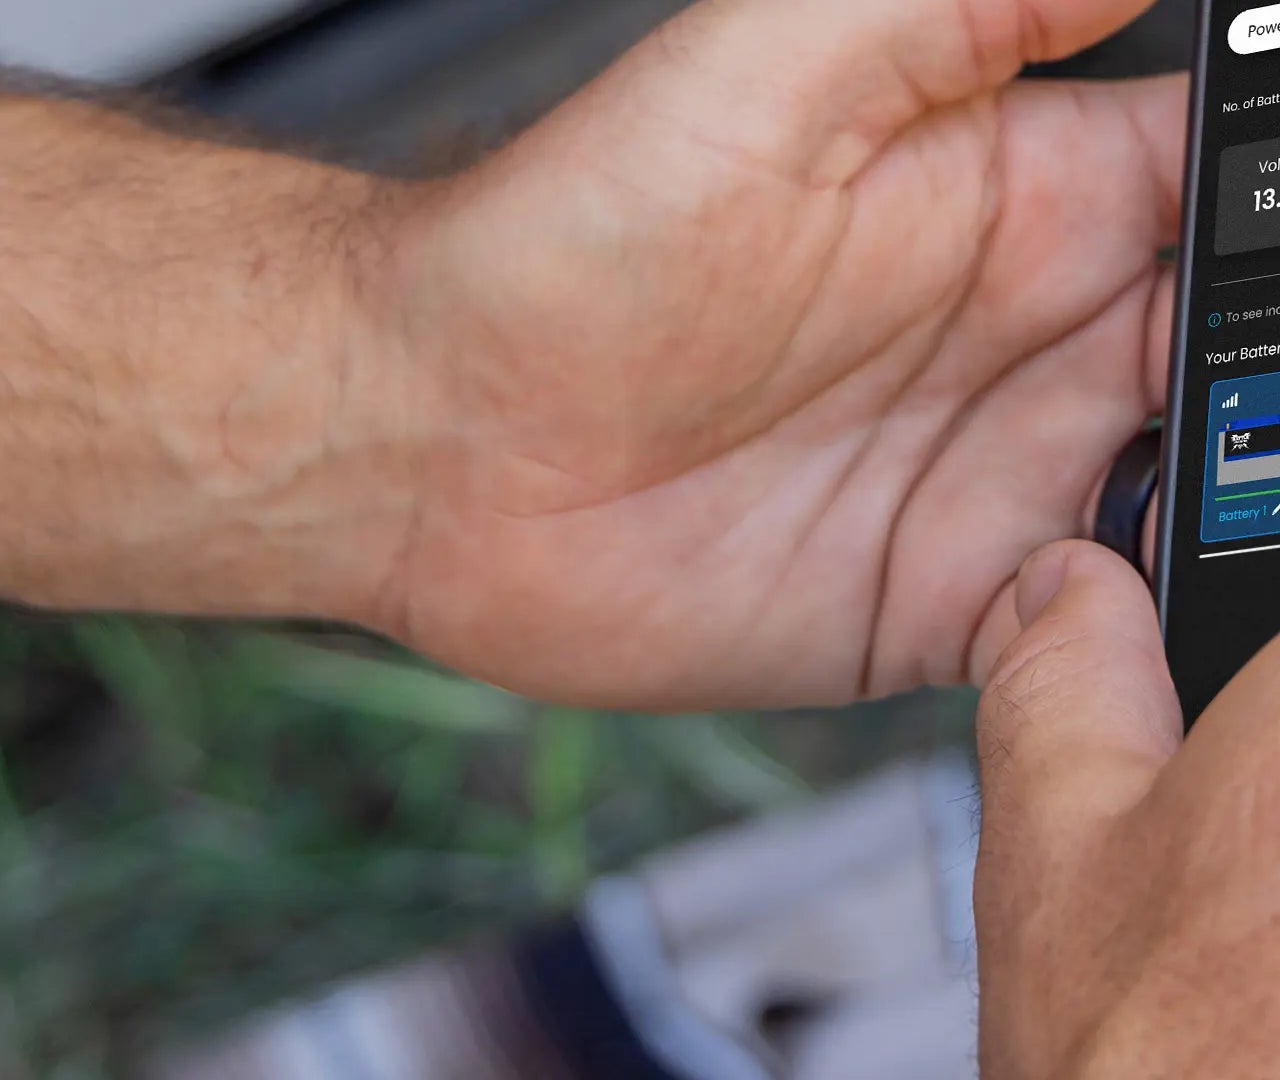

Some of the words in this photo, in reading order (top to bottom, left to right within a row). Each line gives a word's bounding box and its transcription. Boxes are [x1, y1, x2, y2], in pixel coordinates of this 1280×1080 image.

[1222, 101, 1241, 113] No.
[1243, 96, 1255, 109] of
[1226, 311, 1240, 323] To
[1242, 308, 1263, 320] see
[1205, 349, 1237, 366] Your
[1218, 506, 1260, 522] Battery
